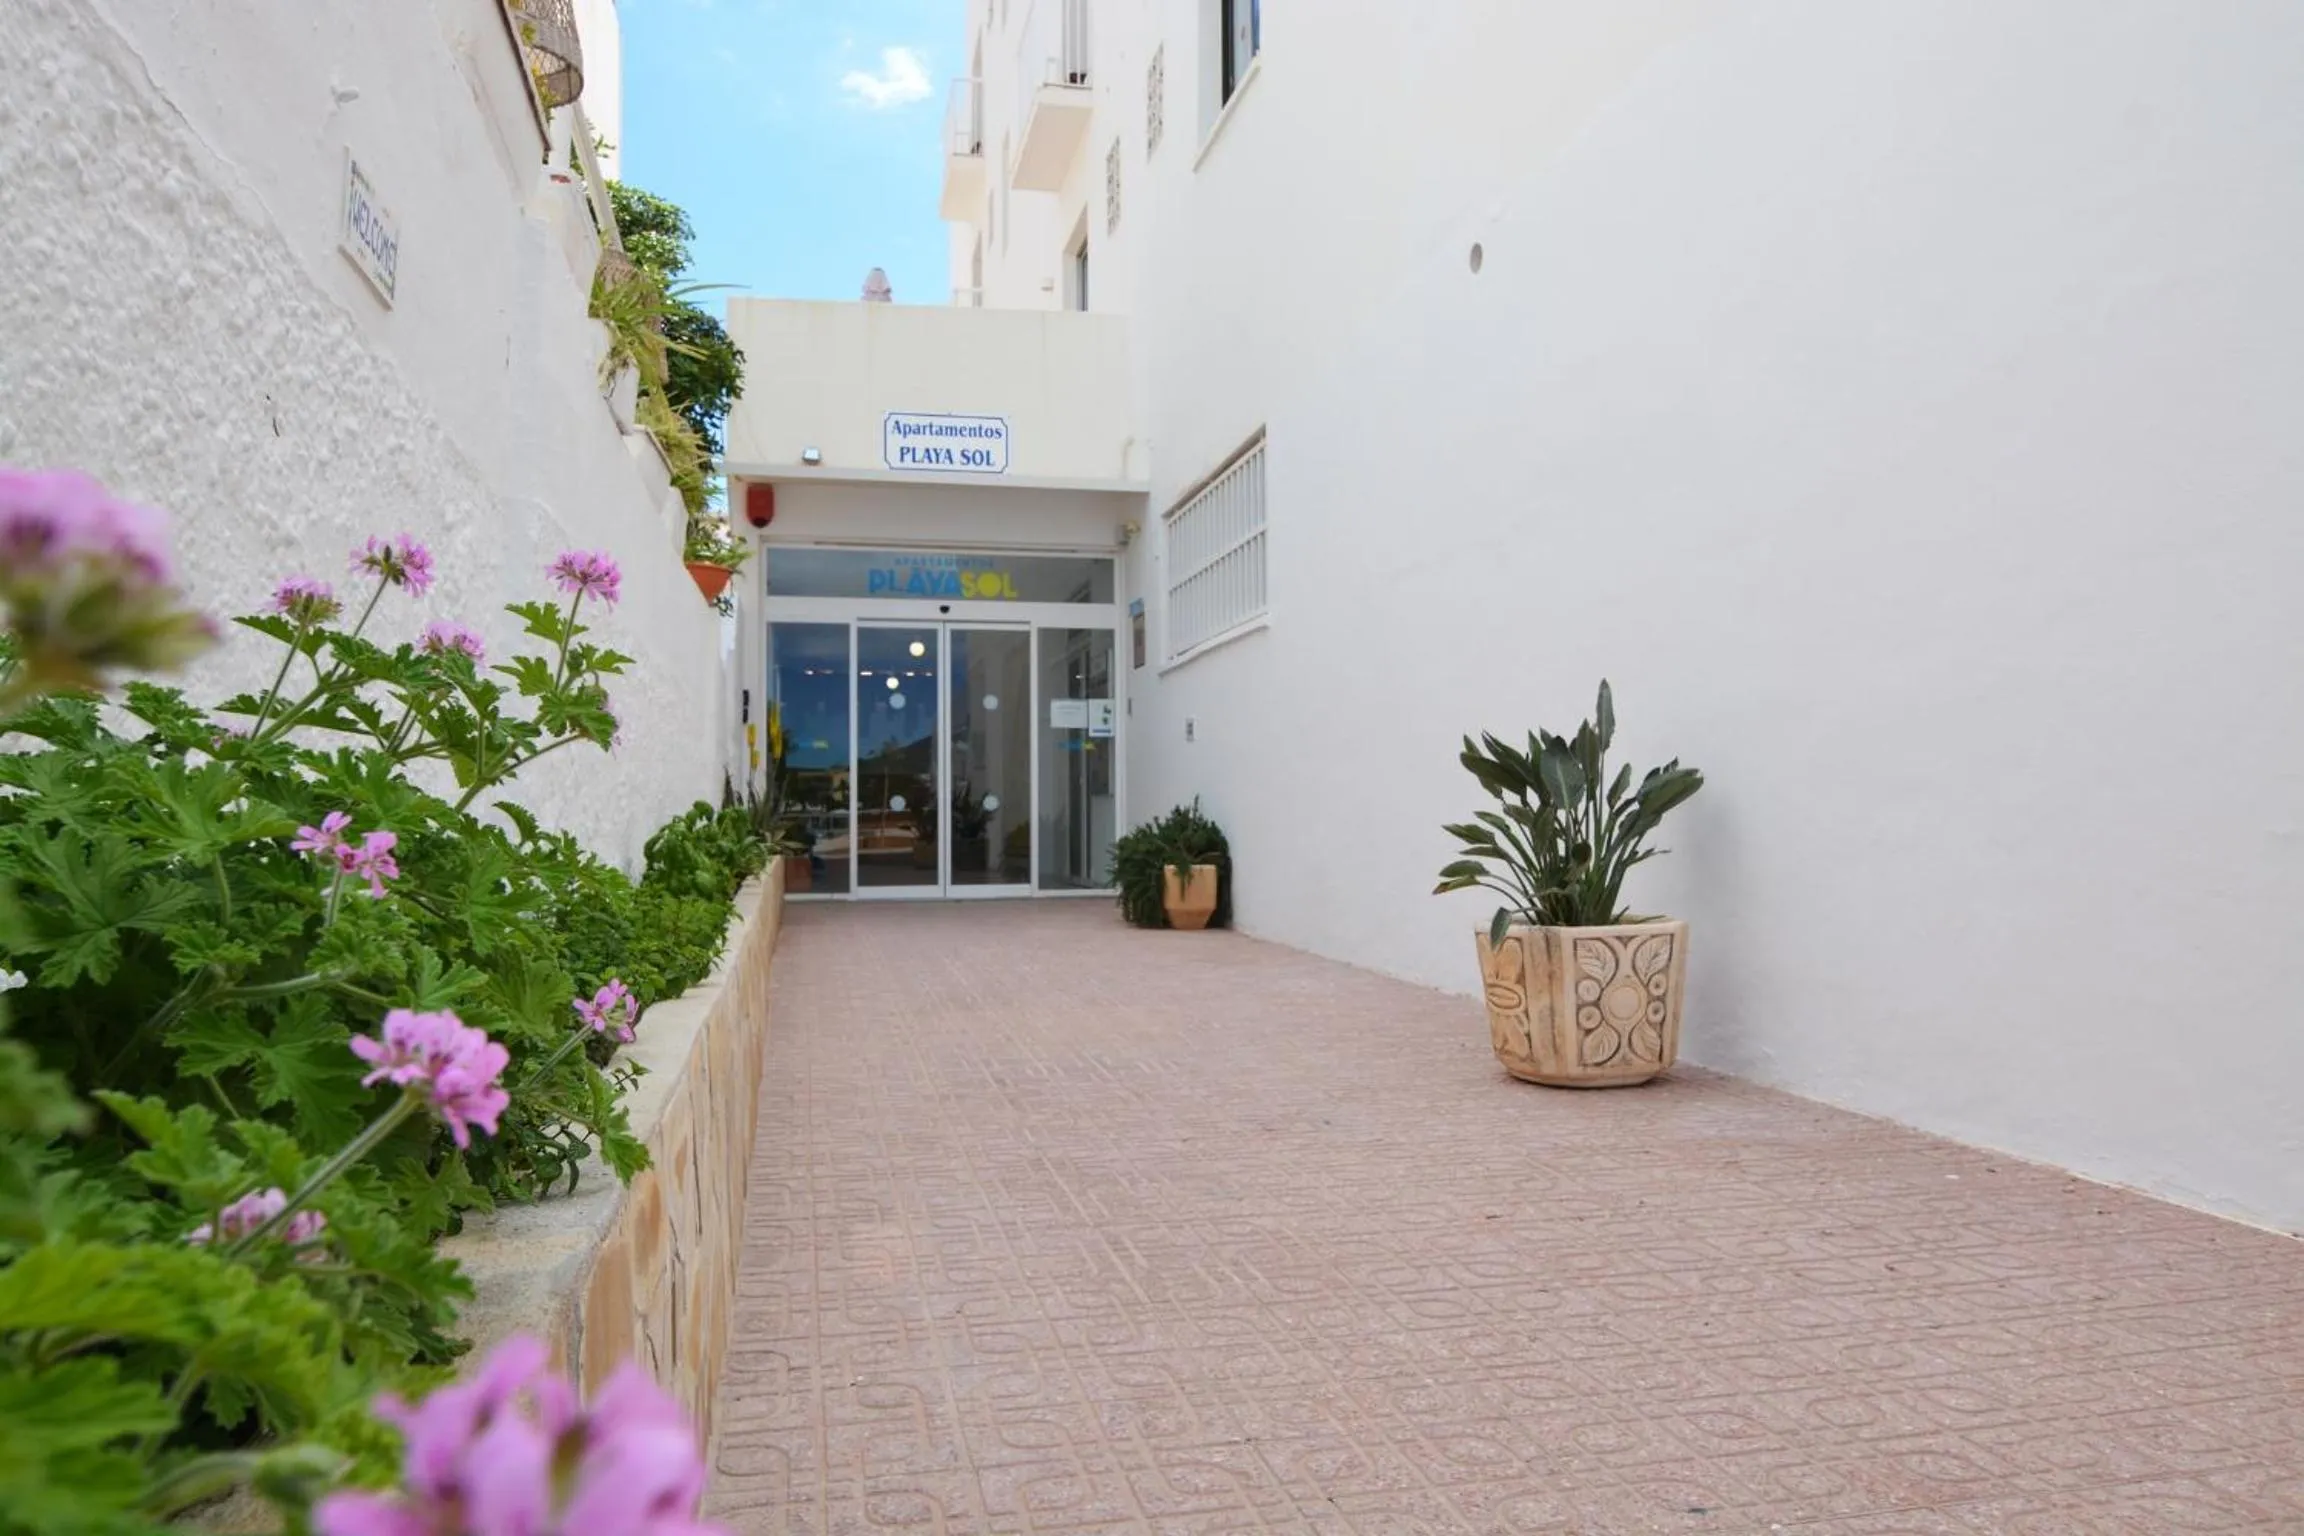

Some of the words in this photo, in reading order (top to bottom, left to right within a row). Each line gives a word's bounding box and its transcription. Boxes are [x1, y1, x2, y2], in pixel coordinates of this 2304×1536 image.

[892, 420, 1003, 439] Apartamentos
[900, 446, 954, 465] PLAYA
[960, 448, 996, 467] SOL
